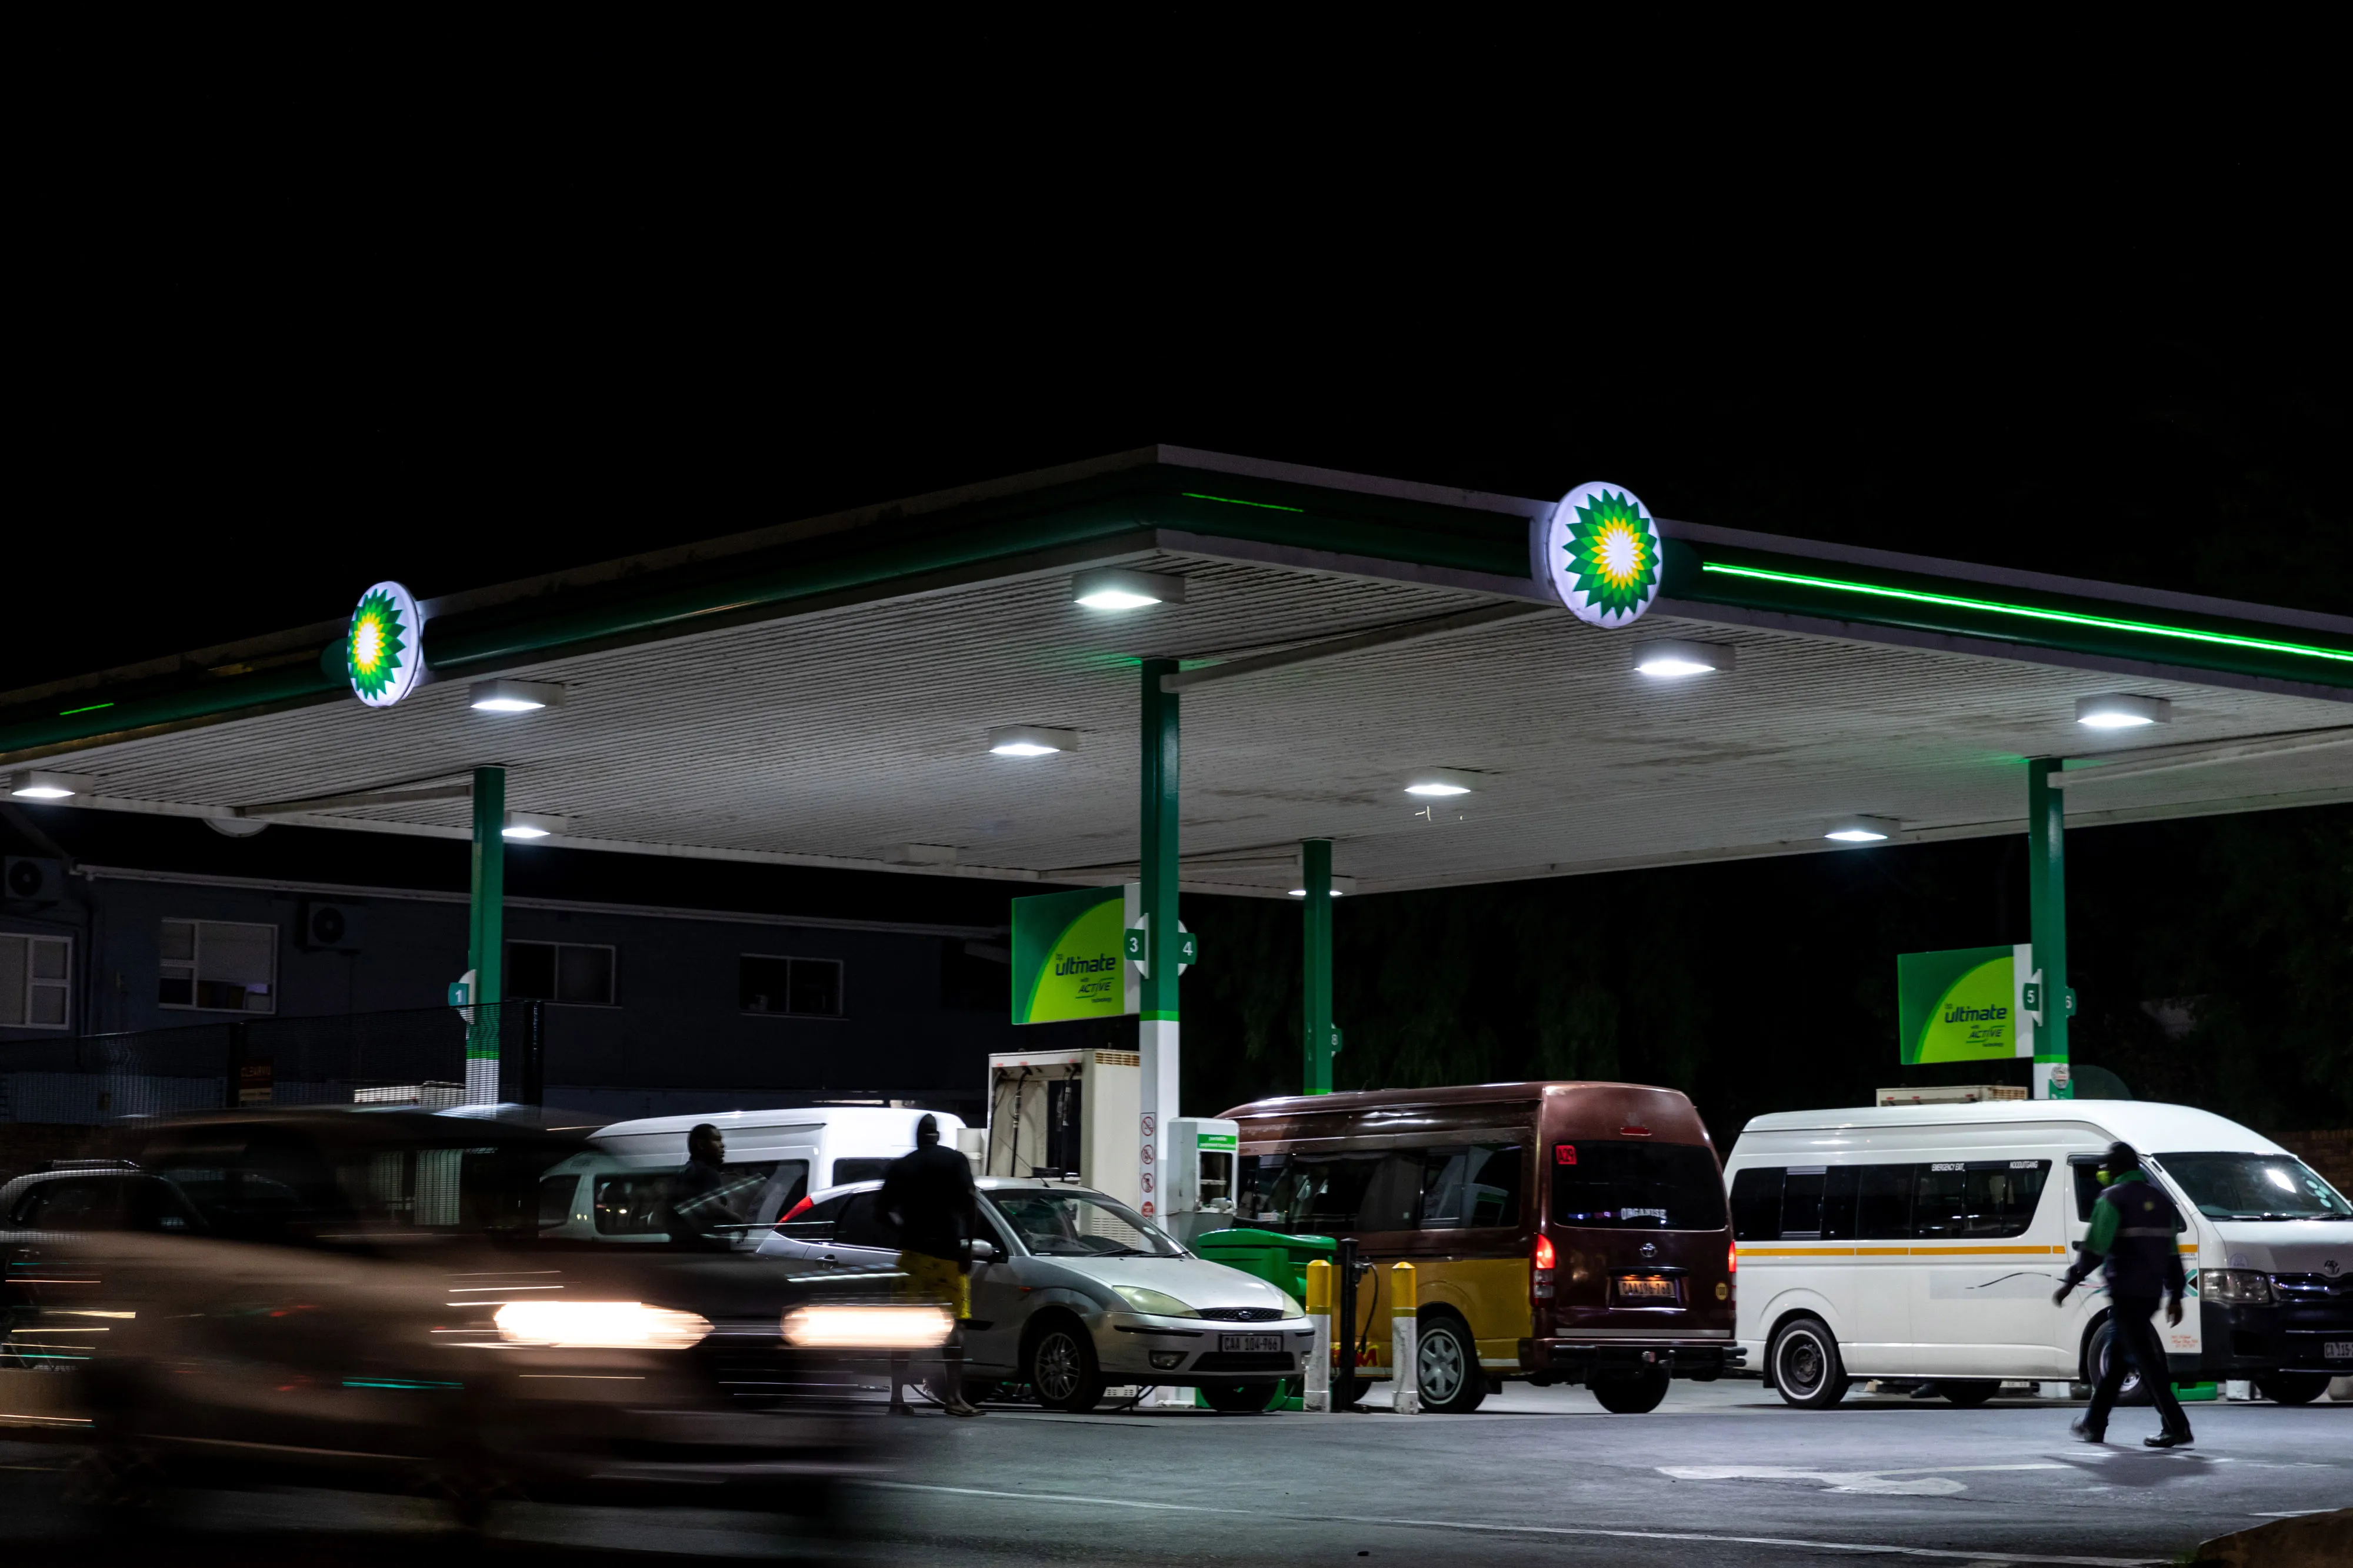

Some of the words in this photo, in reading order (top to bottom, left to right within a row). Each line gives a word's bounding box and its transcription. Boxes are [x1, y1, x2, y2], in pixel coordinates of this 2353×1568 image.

[1129, 937, 1139, 952] 3
[1182, 941, 1193, 956] 4
[1056, 953, 1116, 976] ultimate
[1078, 982, 1112, 993] ACTIVE
[455, 989, 462, 1002] 1
[2027, 990, 2035, 1003] 5
[2065, 995, 2073, 1009] 6
[1945, 1003, 2007, 1023] ultimate
[1968, 1029, 2003, 1039] ACTIVE
[1621, 1208, 1667, 1220] ORGANISE
[2337, 1344, 2353, 1356] 115-
